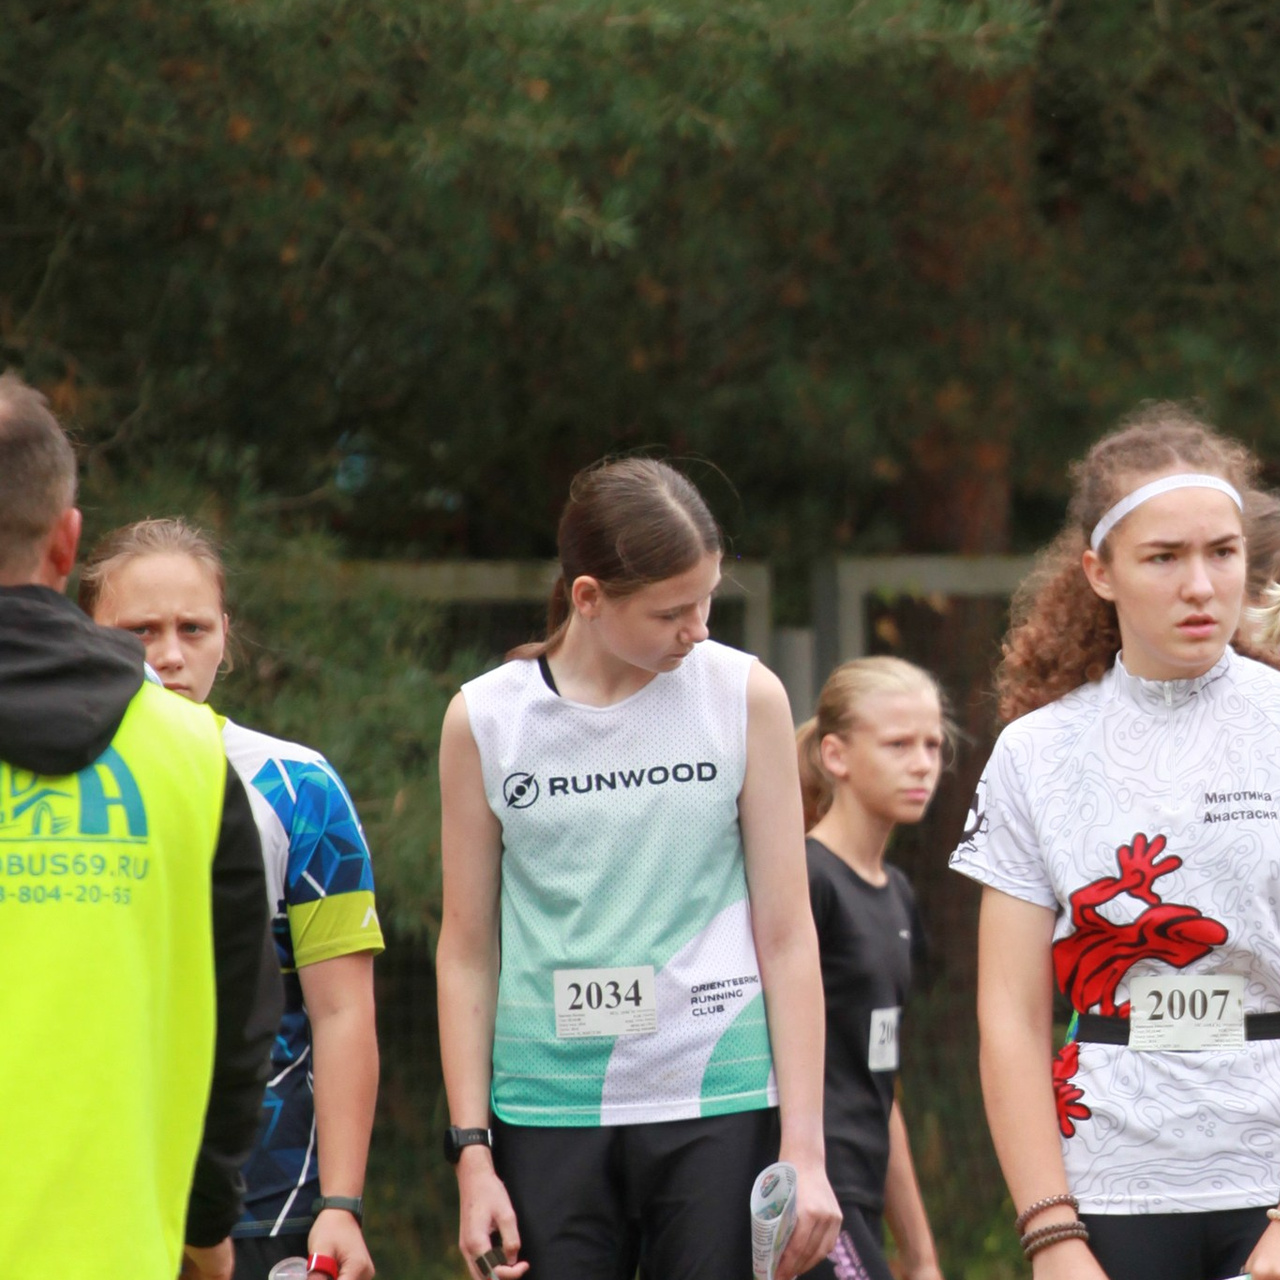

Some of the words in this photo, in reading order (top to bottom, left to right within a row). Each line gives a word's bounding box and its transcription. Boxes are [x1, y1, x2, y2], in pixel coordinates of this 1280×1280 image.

[548, 761, 718, 797] RUNWOOD
[1204, 791, 1272, 805] Мяготина
[1203, 809, 1278, 825] Анастасия
[0, 853, 149, 880] BUS69.RU
[567, 979, 642, 1011] 2034
[690, 975, 758, 995] ORIENTEERING
[690, 989, 743, 1006] RUNNING
[1147, 988, 1230, 1021] 2007
[691, 1004, 725, 1018] CLUB
